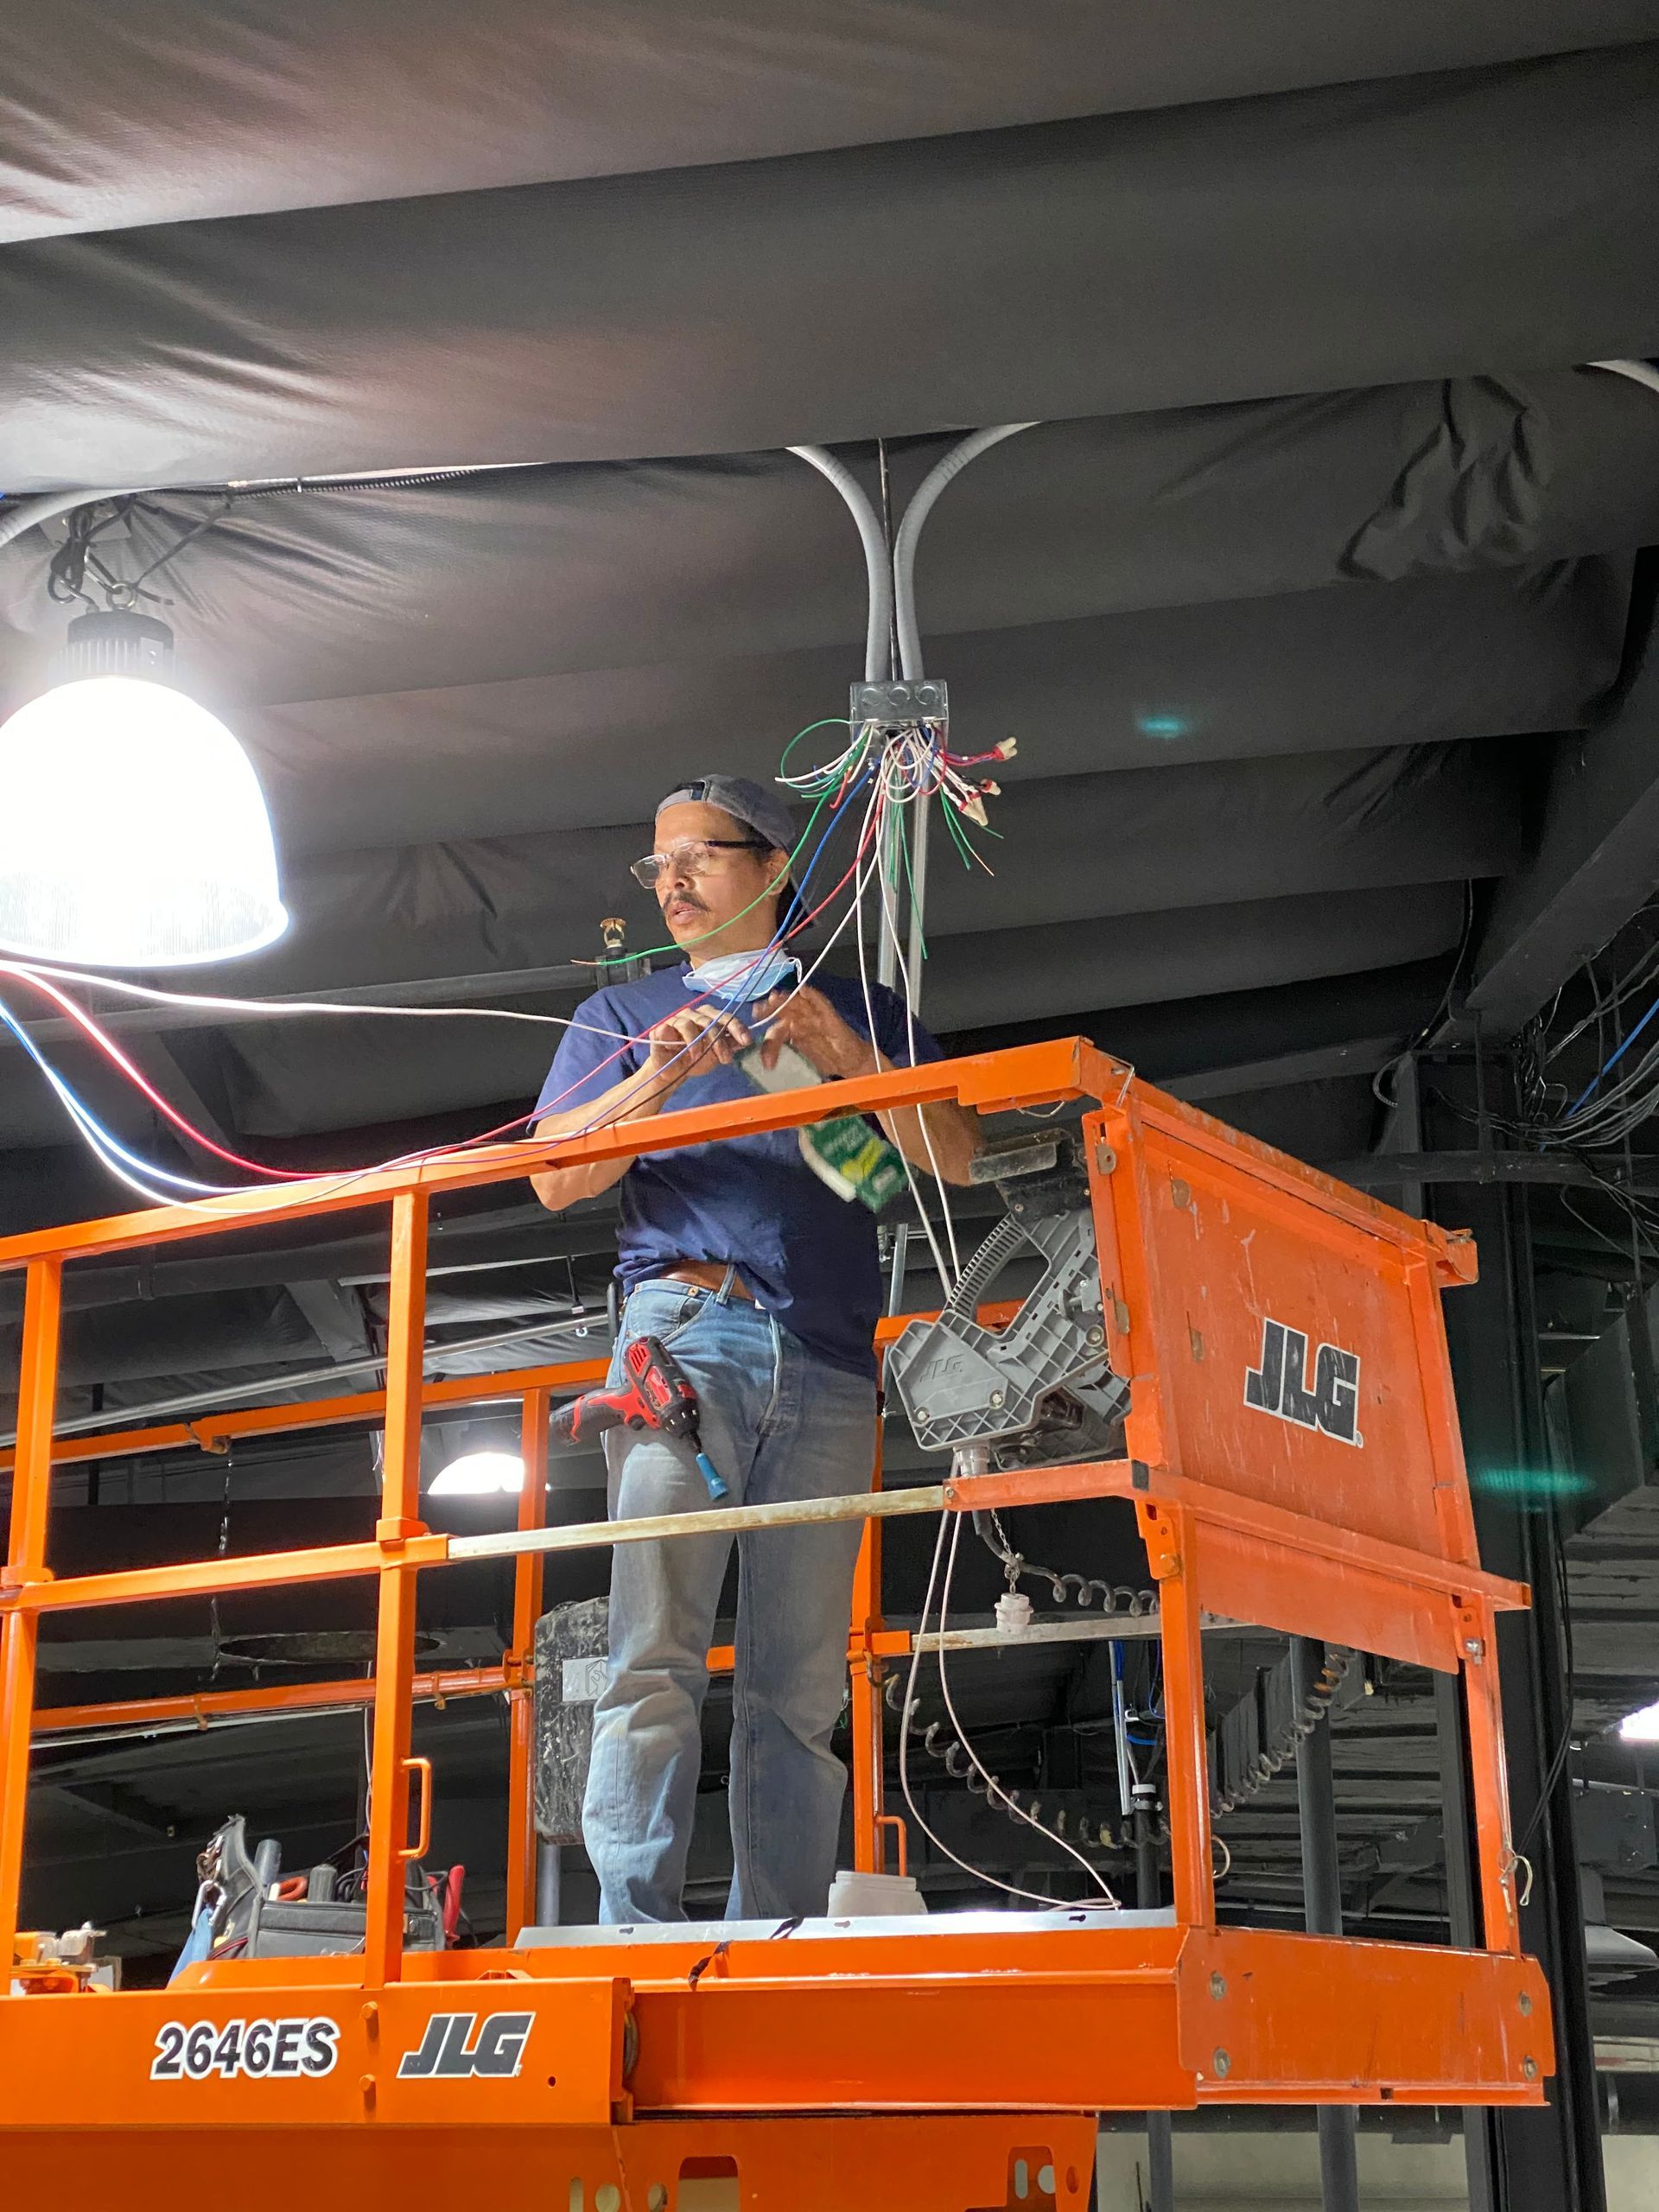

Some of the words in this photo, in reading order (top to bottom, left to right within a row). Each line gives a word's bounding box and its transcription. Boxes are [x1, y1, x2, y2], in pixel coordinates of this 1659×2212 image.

[919, 1353, 964, 1382] JLG
[1244, 1317, 1360, 1446] JLG
[151, 2018, 340, 2078] 2646ES
[397, 2012, 536, 2078] JLG
